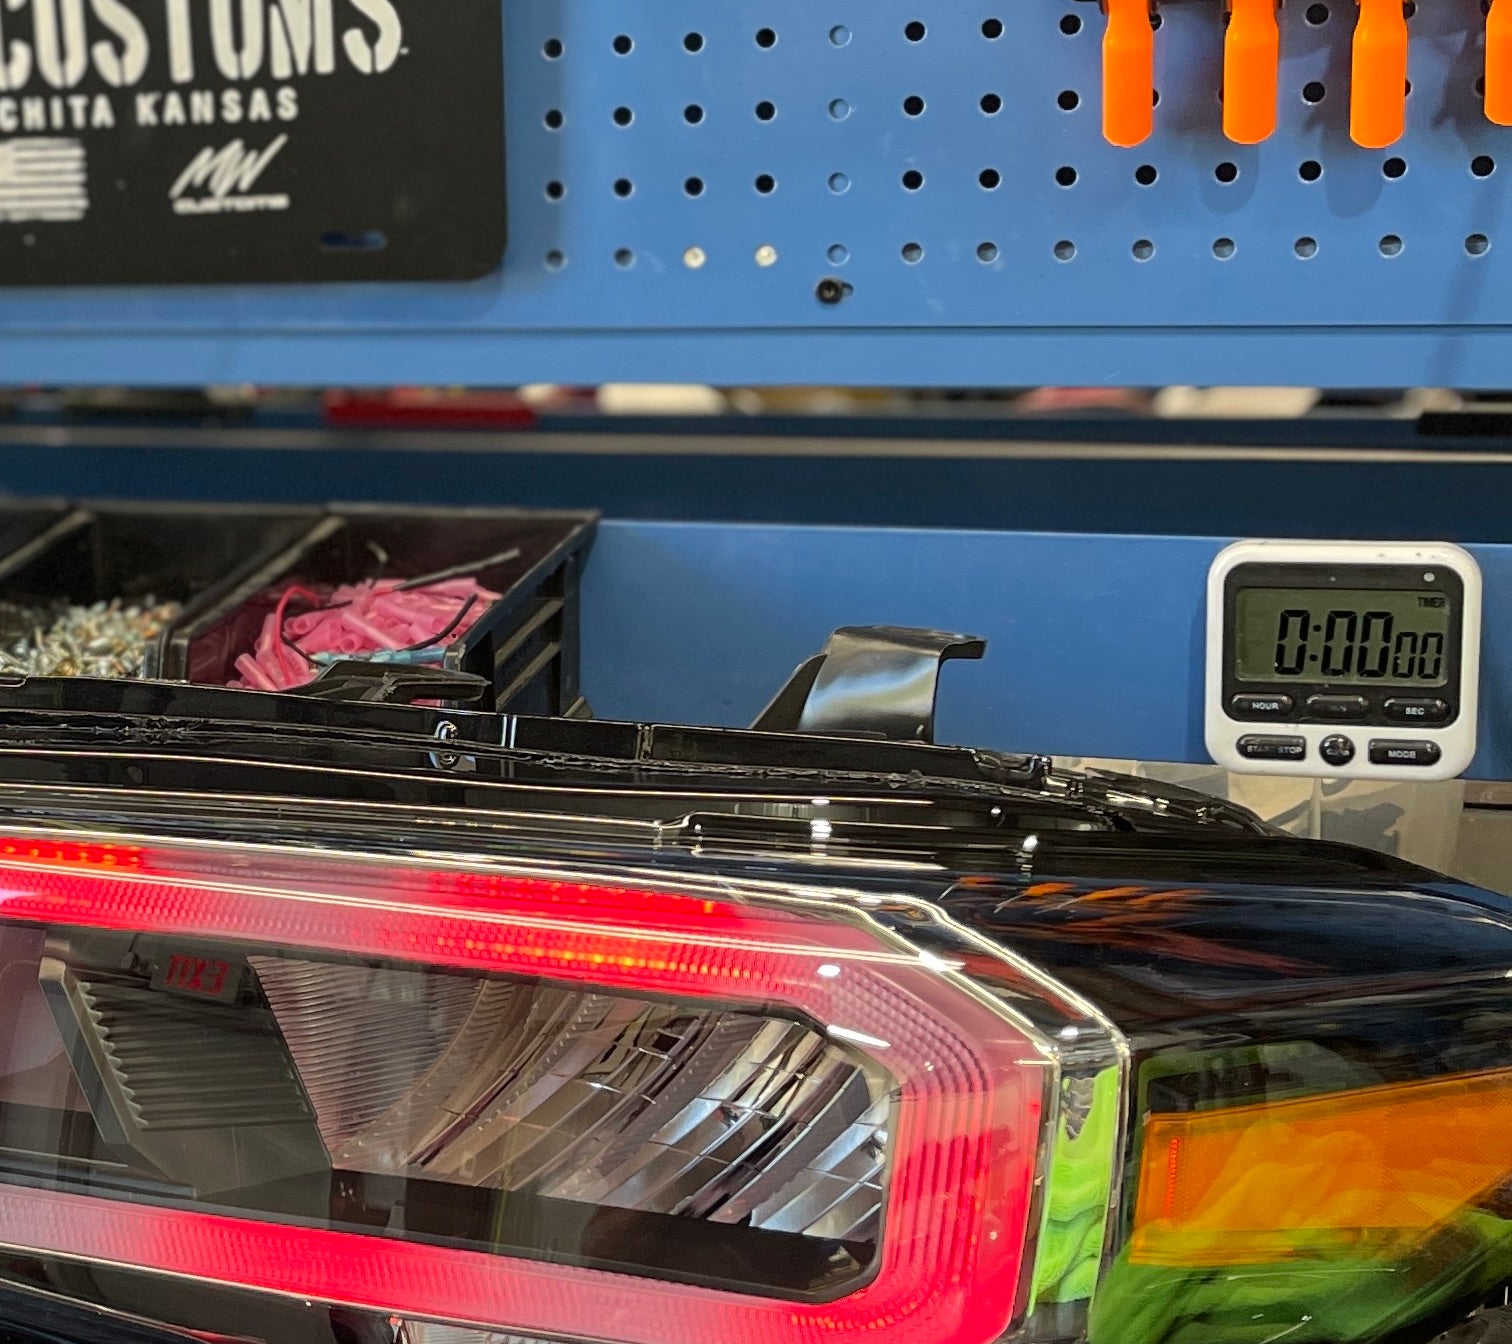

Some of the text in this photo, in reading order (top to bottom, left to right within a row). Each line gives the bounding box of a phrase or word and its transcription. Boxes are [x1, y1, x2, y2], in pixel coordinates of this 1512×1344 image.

[136, 87, 299, 126] KANSAS
[1252, 702, 1279, 711] HOUR
[1405, 707, 1426, 716] SEC
